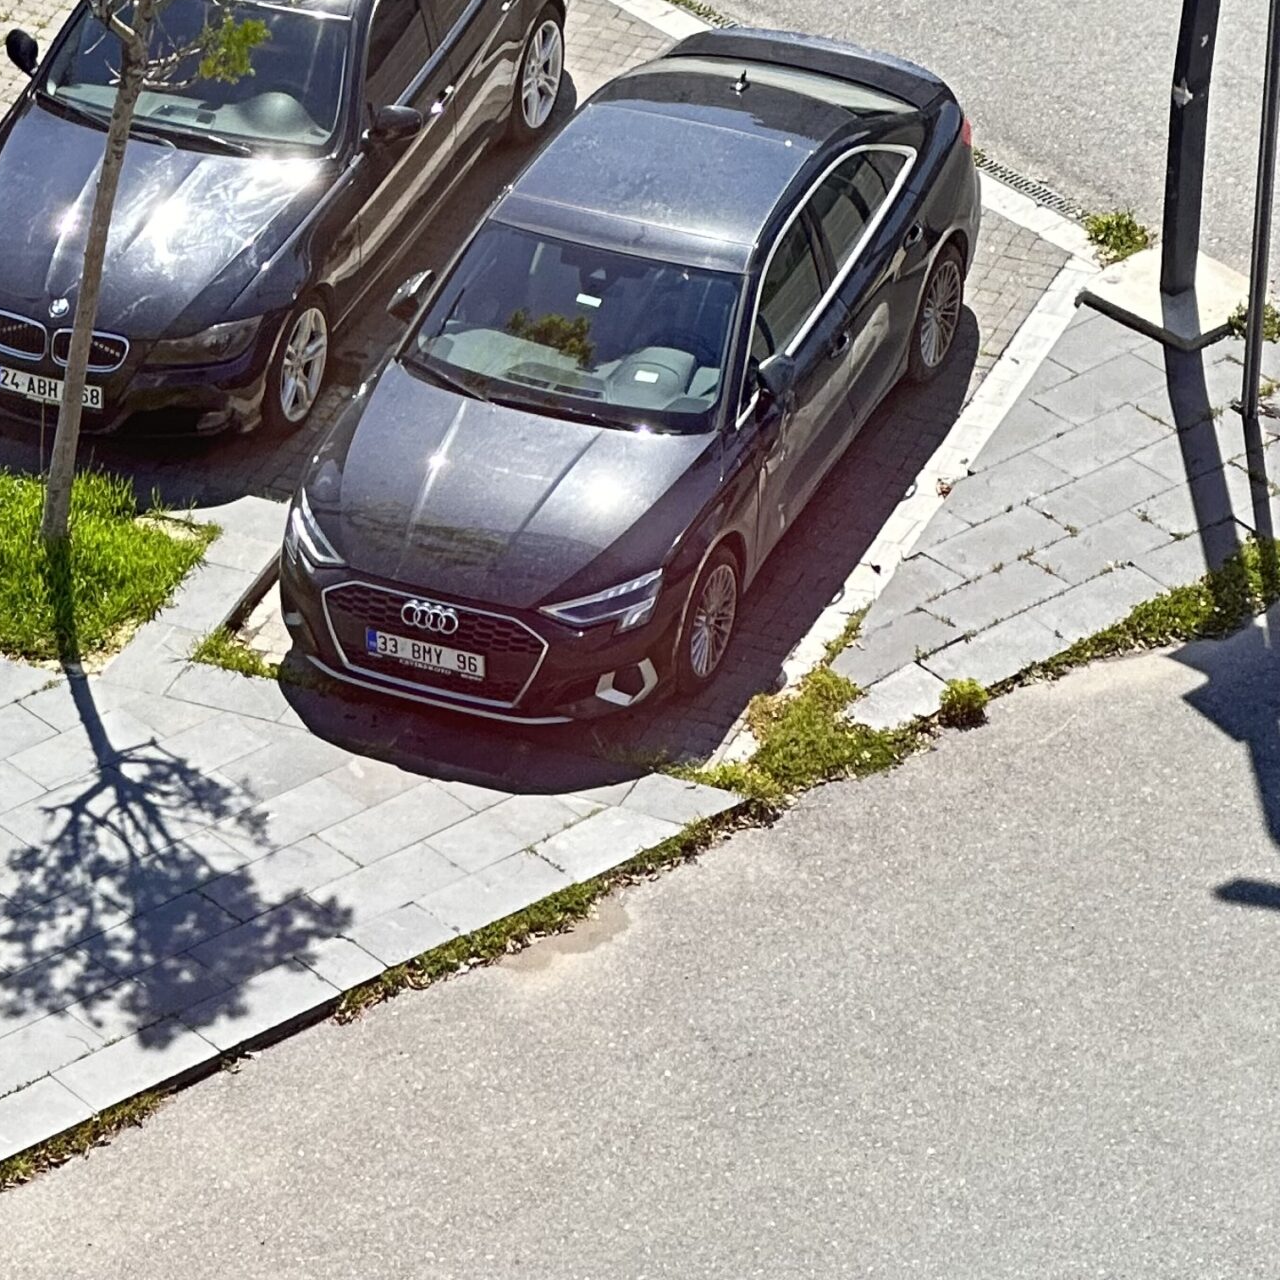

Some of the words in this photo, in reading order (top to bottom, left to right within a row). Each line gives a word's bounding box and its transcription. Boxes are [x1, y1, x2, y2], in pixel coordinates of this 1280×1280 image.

[1, 368, 20, 390] 24
[26, 376, 58, 398] ABH
[378, 635, 399, 654] 33
[411, 642, 443, 665] BMY
[456, 653, 478, 673] 96
